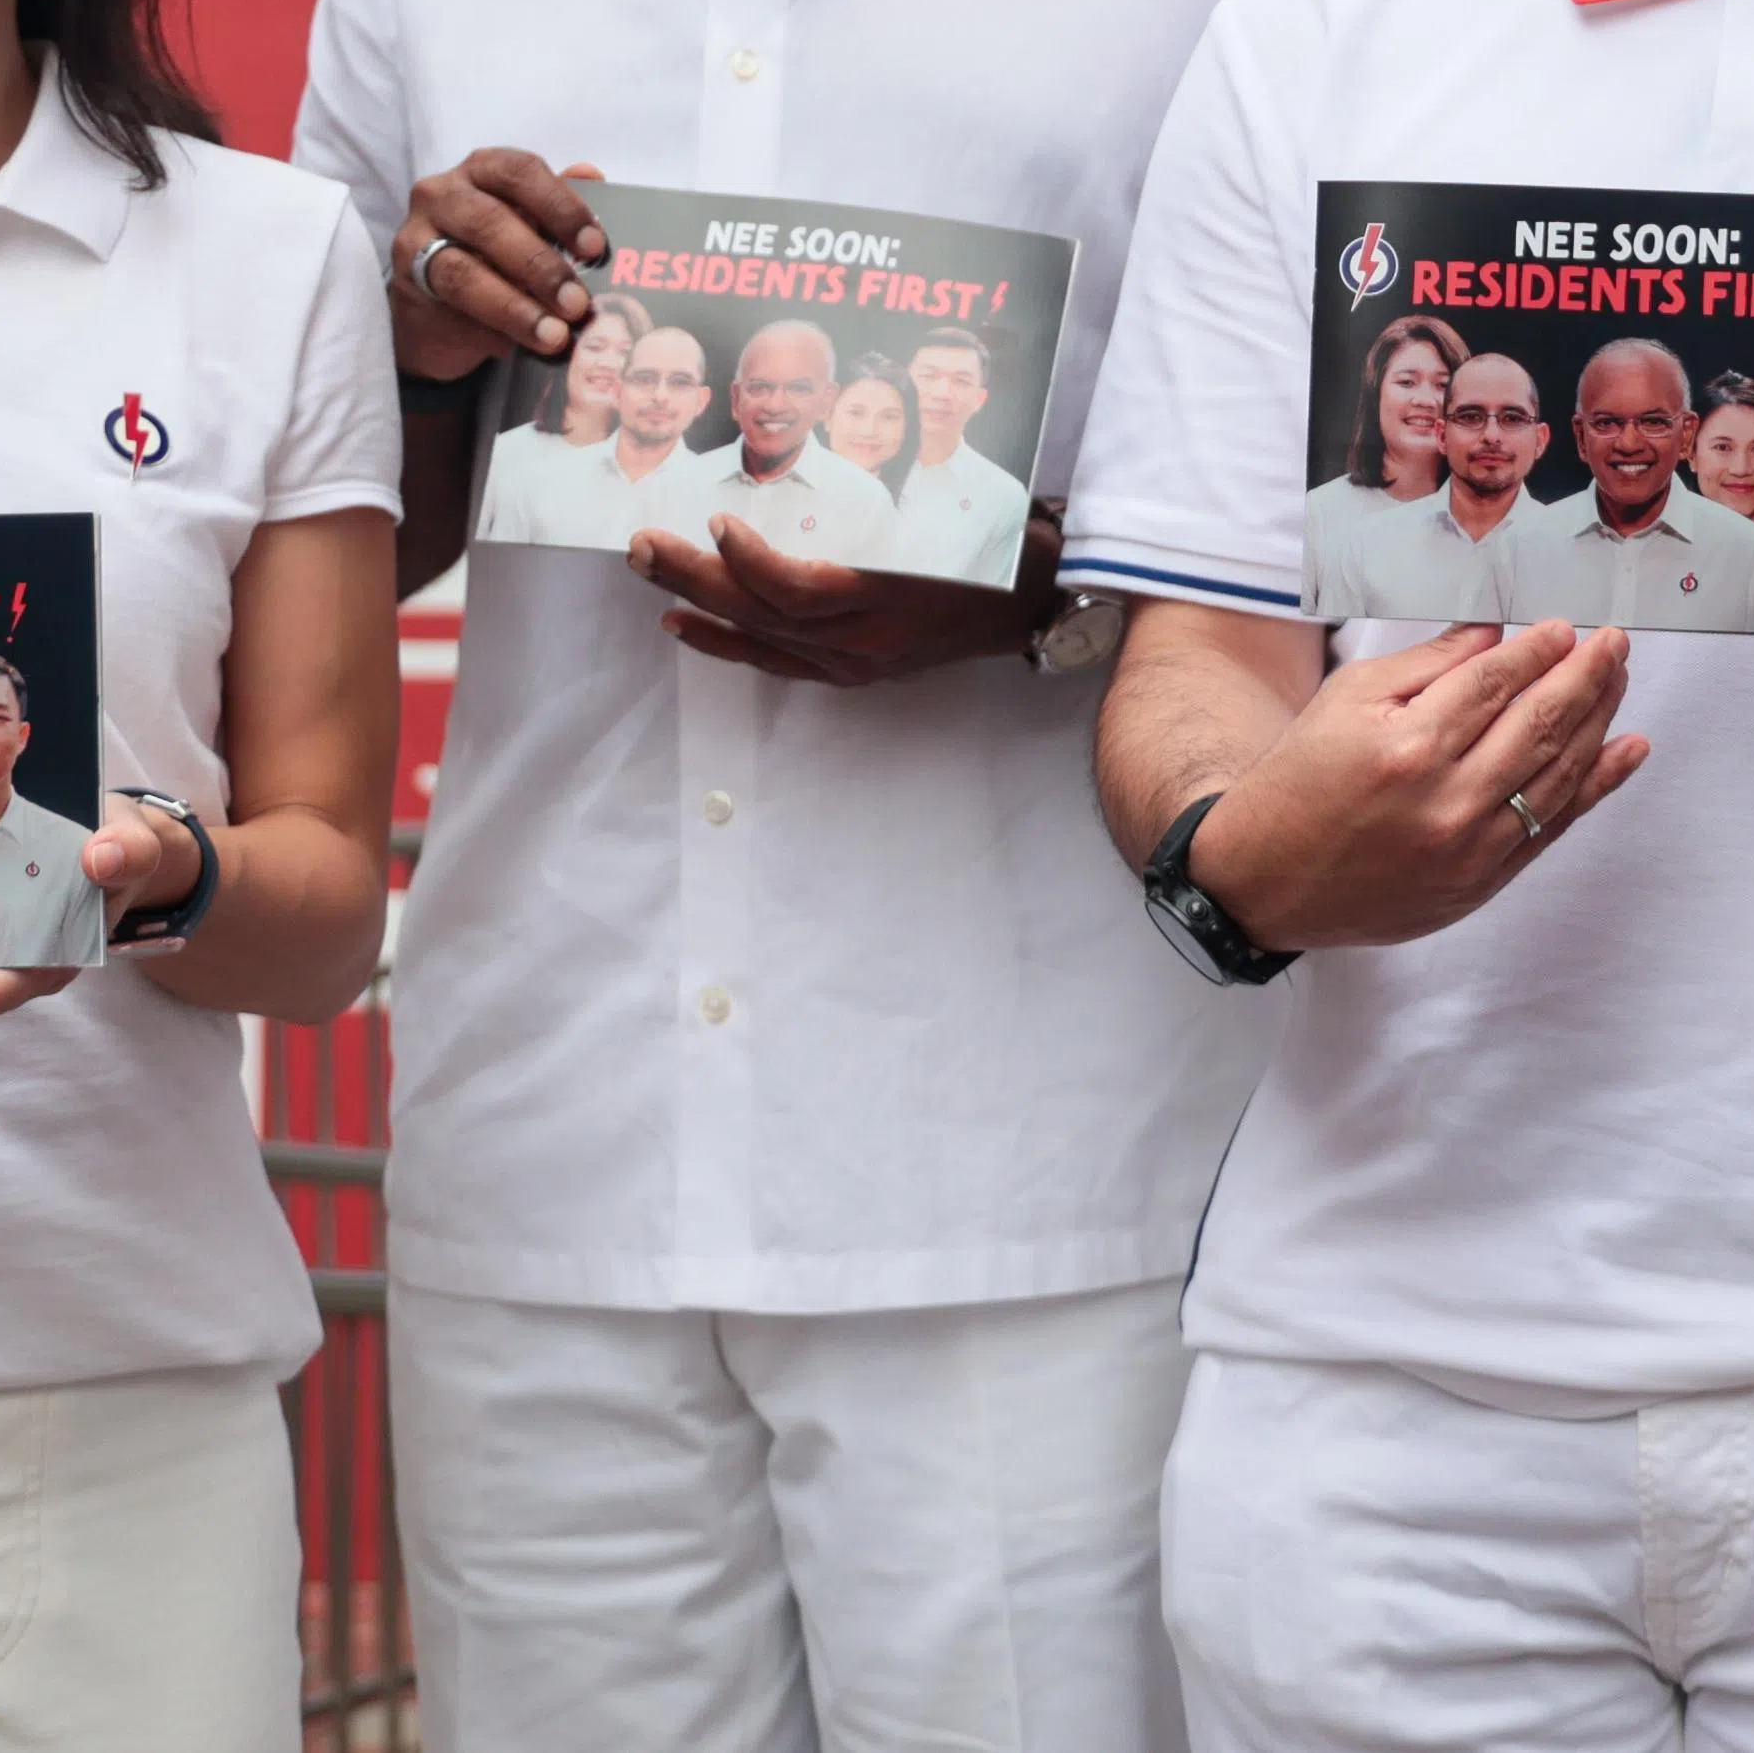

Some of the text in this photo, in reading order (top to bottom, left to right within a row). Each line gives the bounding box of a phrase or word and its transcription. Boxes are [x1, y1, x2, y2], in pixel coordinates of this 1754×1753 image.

[703, 220, 902, 270] NEE SOON:
[1514, 220, 1741, 266] NEE SOON:
[610, 246, 848, 304] RESIDENTS
[1411, 259, 1688, 316] RESIDENTS
